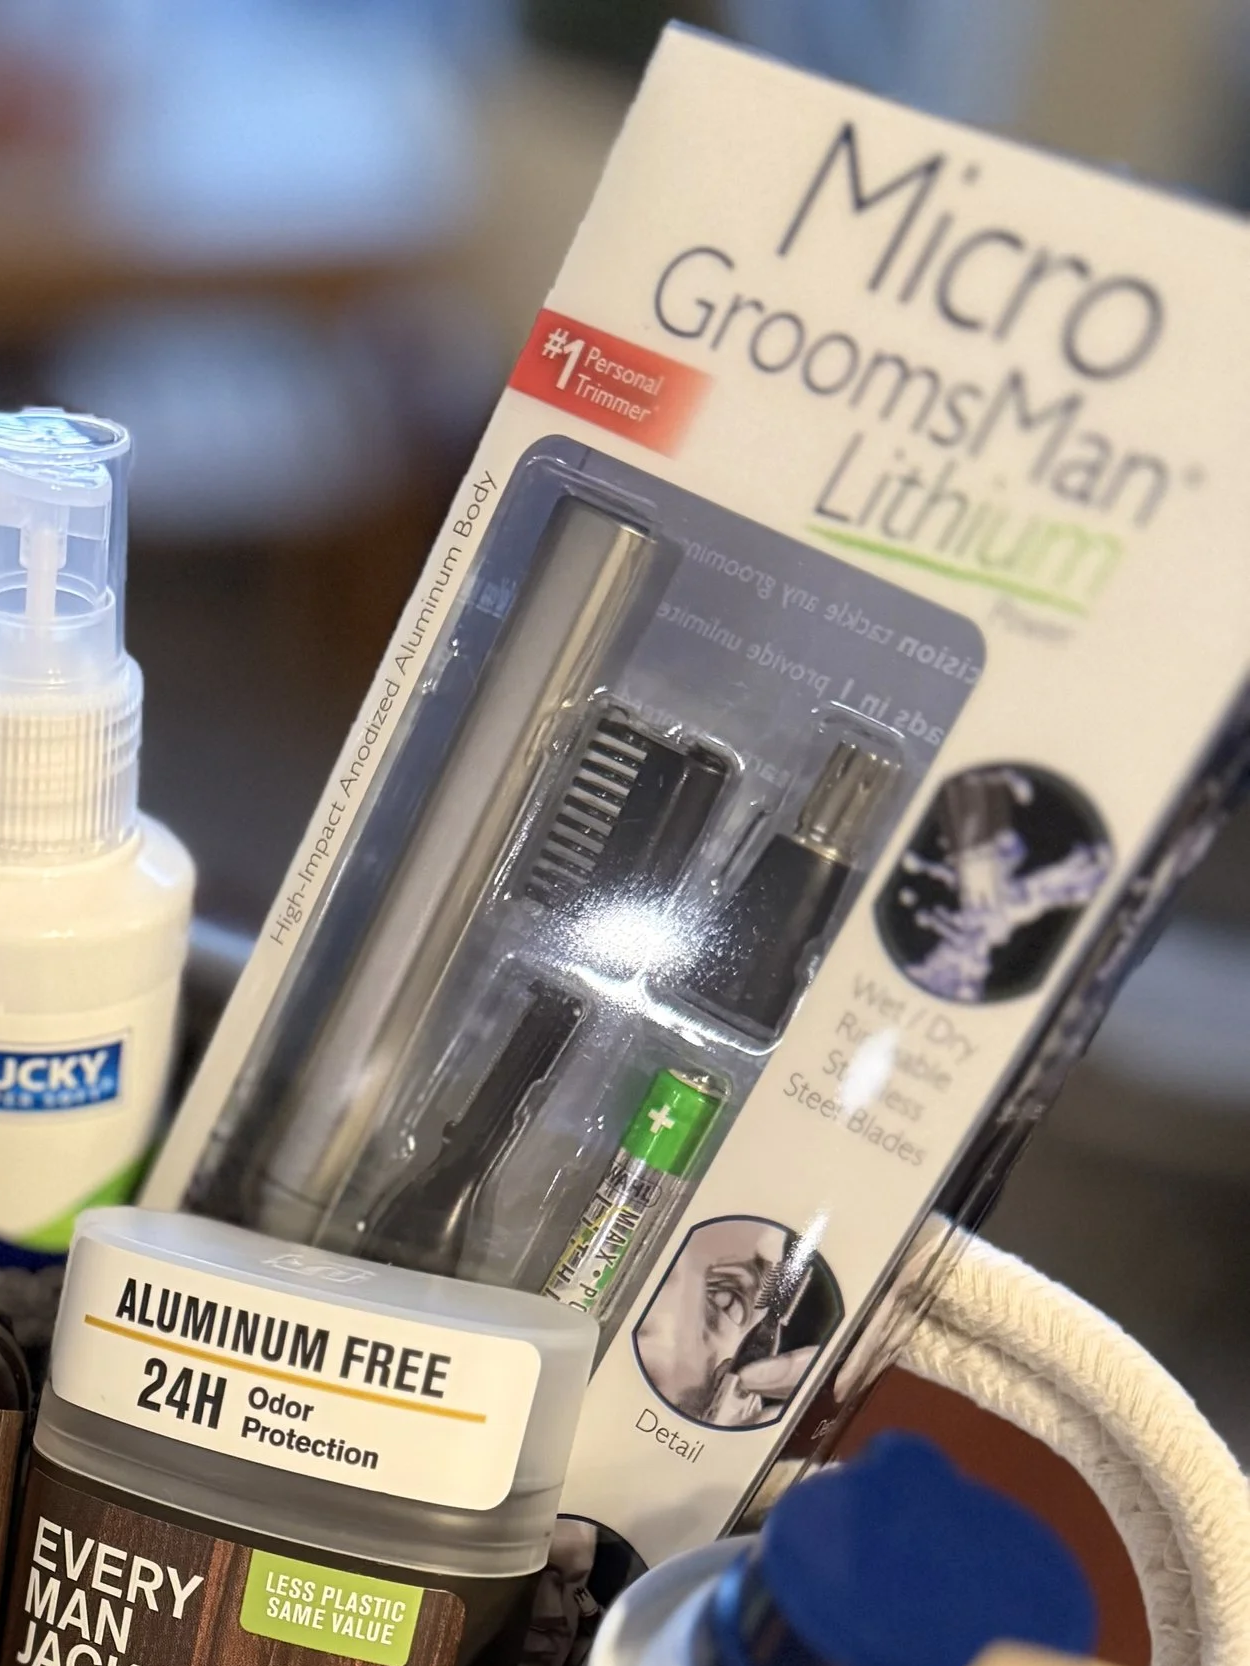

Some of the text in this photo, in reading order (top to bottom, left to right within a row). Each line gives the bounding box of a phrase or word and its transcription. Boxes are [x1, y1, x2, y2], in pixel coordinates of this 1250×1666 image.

[776, 120, 1166, 382] Micro
[541, 327, 586, 391] #1
[583, 346, 666, 397] Personal
[575, 373, 653, 423] Trimmer
[813, 431, 1126, 598] Lithium
[269, 801, 346, 947] High-Impact
[339, 680, 402, 798] Anodized
[393, 543, 463, 677] Aluminum
[453, 470, 498, 538] Body
[852, 972, 906, 1023] Wet
[925, 1013, 979, 1066] Dry
[846, 1107, 928, 1168] Blades
[596, 1208, 641, 1269] MAX
[115, 1277, 452, 1400] ALUMINUM FREE
[137, 1356, 314, 1431] 24H Odor
[241, 1417, 380, 1470] Protection
[635, 1408, 705, 1464] Detail
[32, 1516, 205, 1622] EVERY
[265, 1571, 407, 1623] LESS PLASTIC
[23, 1574, 134, 1655] MAN
[266, 1596, 396, 1646] SAME VALUE
